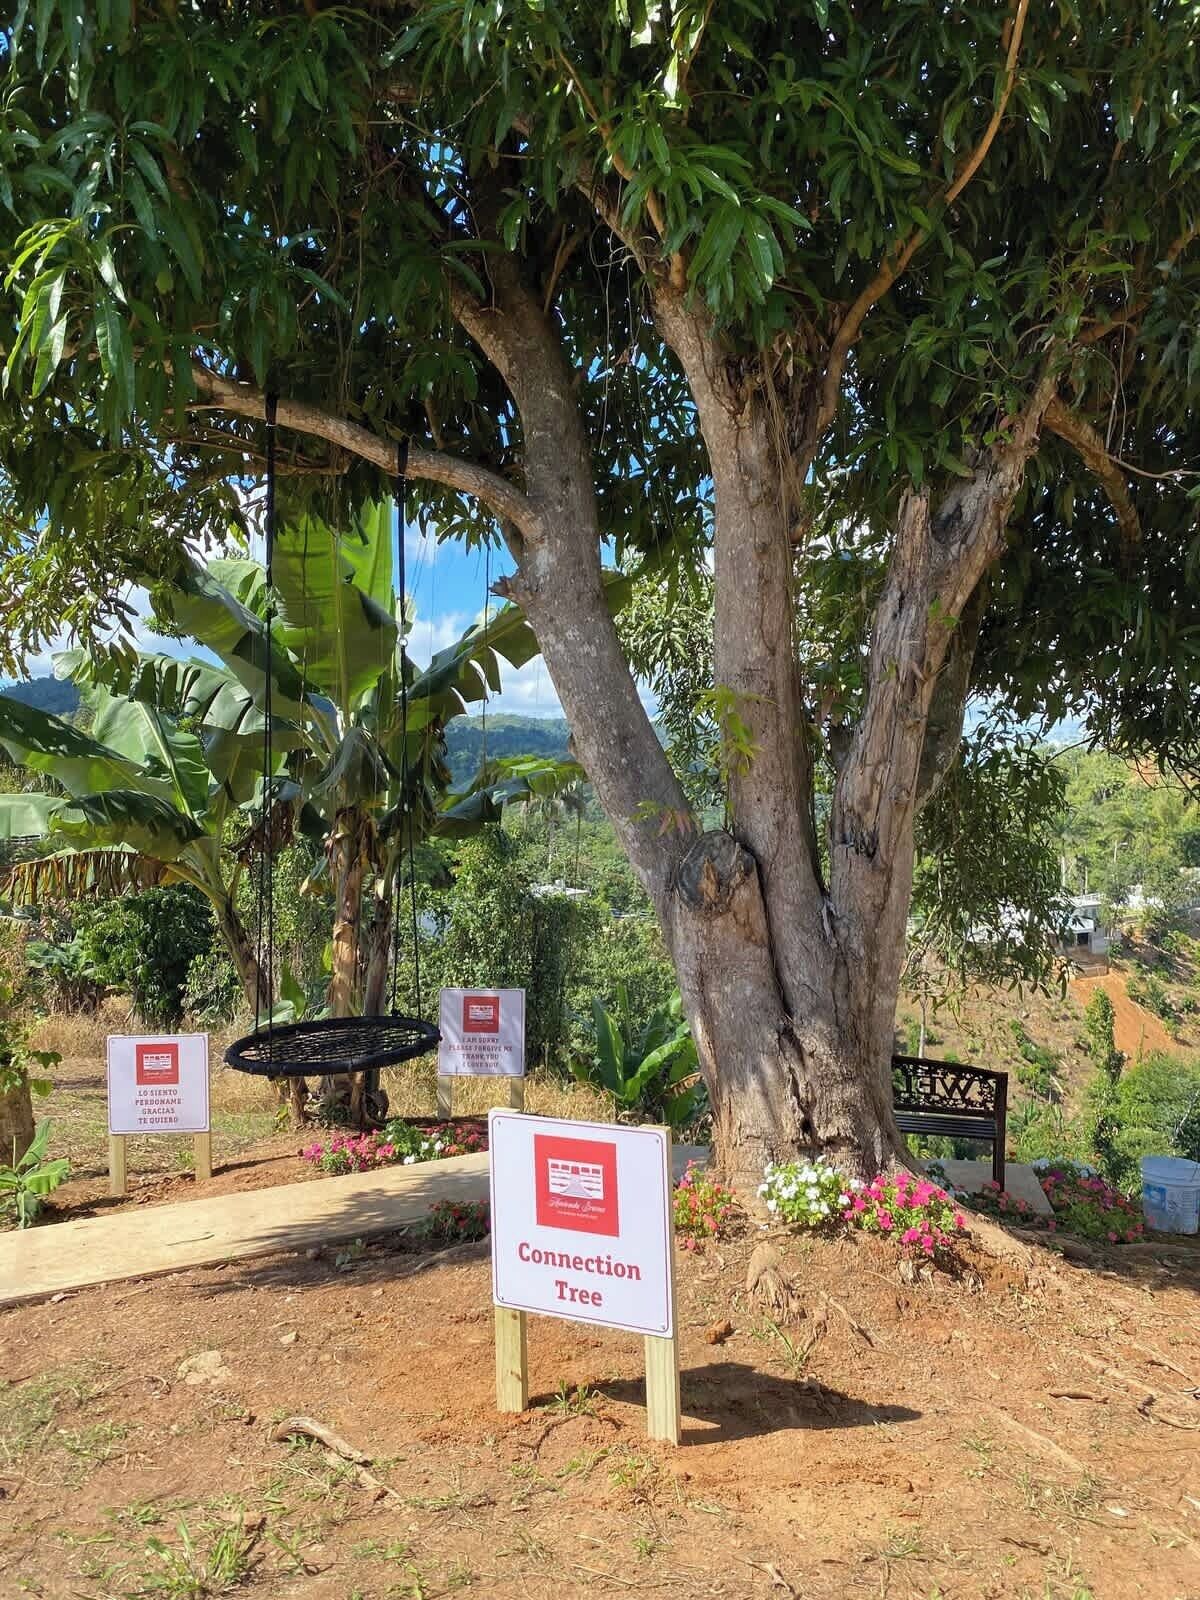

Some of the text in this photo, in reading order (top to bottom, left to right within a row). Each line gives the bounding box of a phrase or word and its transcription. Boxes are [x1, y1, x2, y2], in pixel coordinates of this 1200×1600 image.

[135, 1098, 181, 1106] PERDONAME
[142, 1107, 175, 1115] GRACIAS
[149, 1116, 178, 1124] QUIERO
[518, 1242, 642, 1281] Connection
[555, 1279, 603, 1307] Tree
